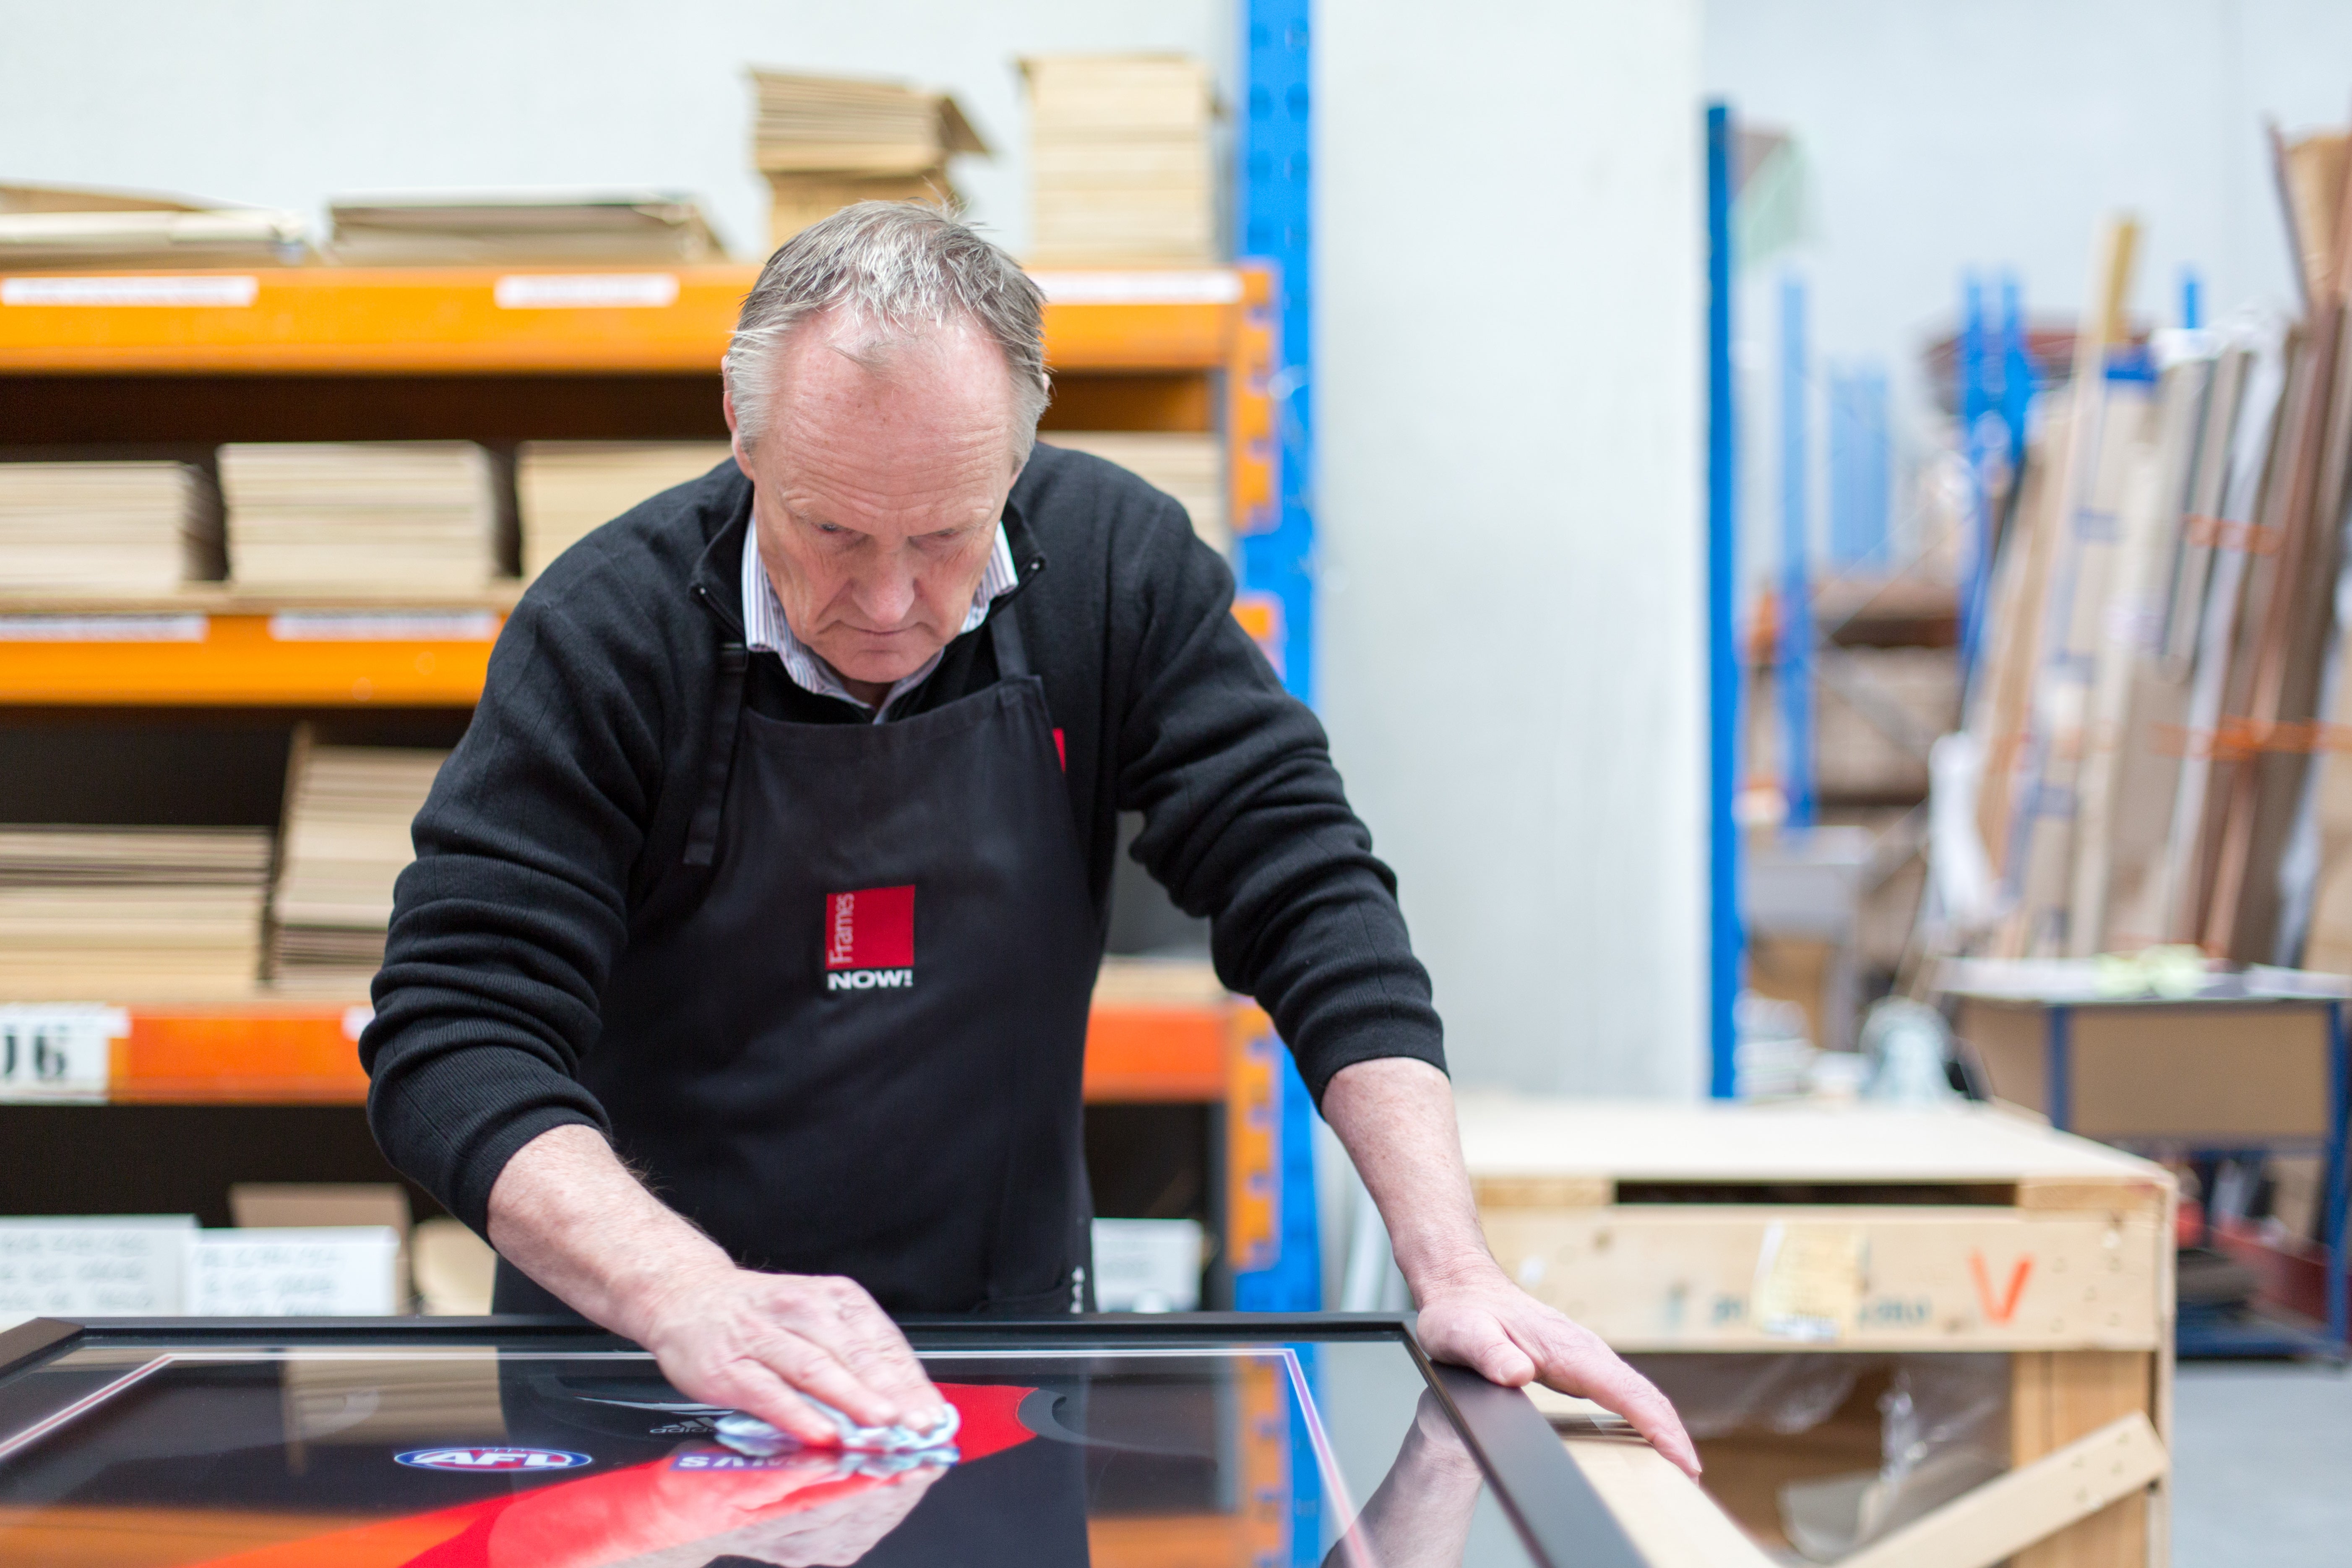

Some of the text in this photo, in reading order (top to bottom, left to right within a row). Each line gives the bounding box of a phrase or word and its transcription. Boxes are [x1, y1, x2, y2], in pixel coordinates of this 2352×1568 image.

[828, 893, 854, 965] Frames
[827, 969, 914, 990] NOW!
[409, 1451, 572, 1466] AFL
